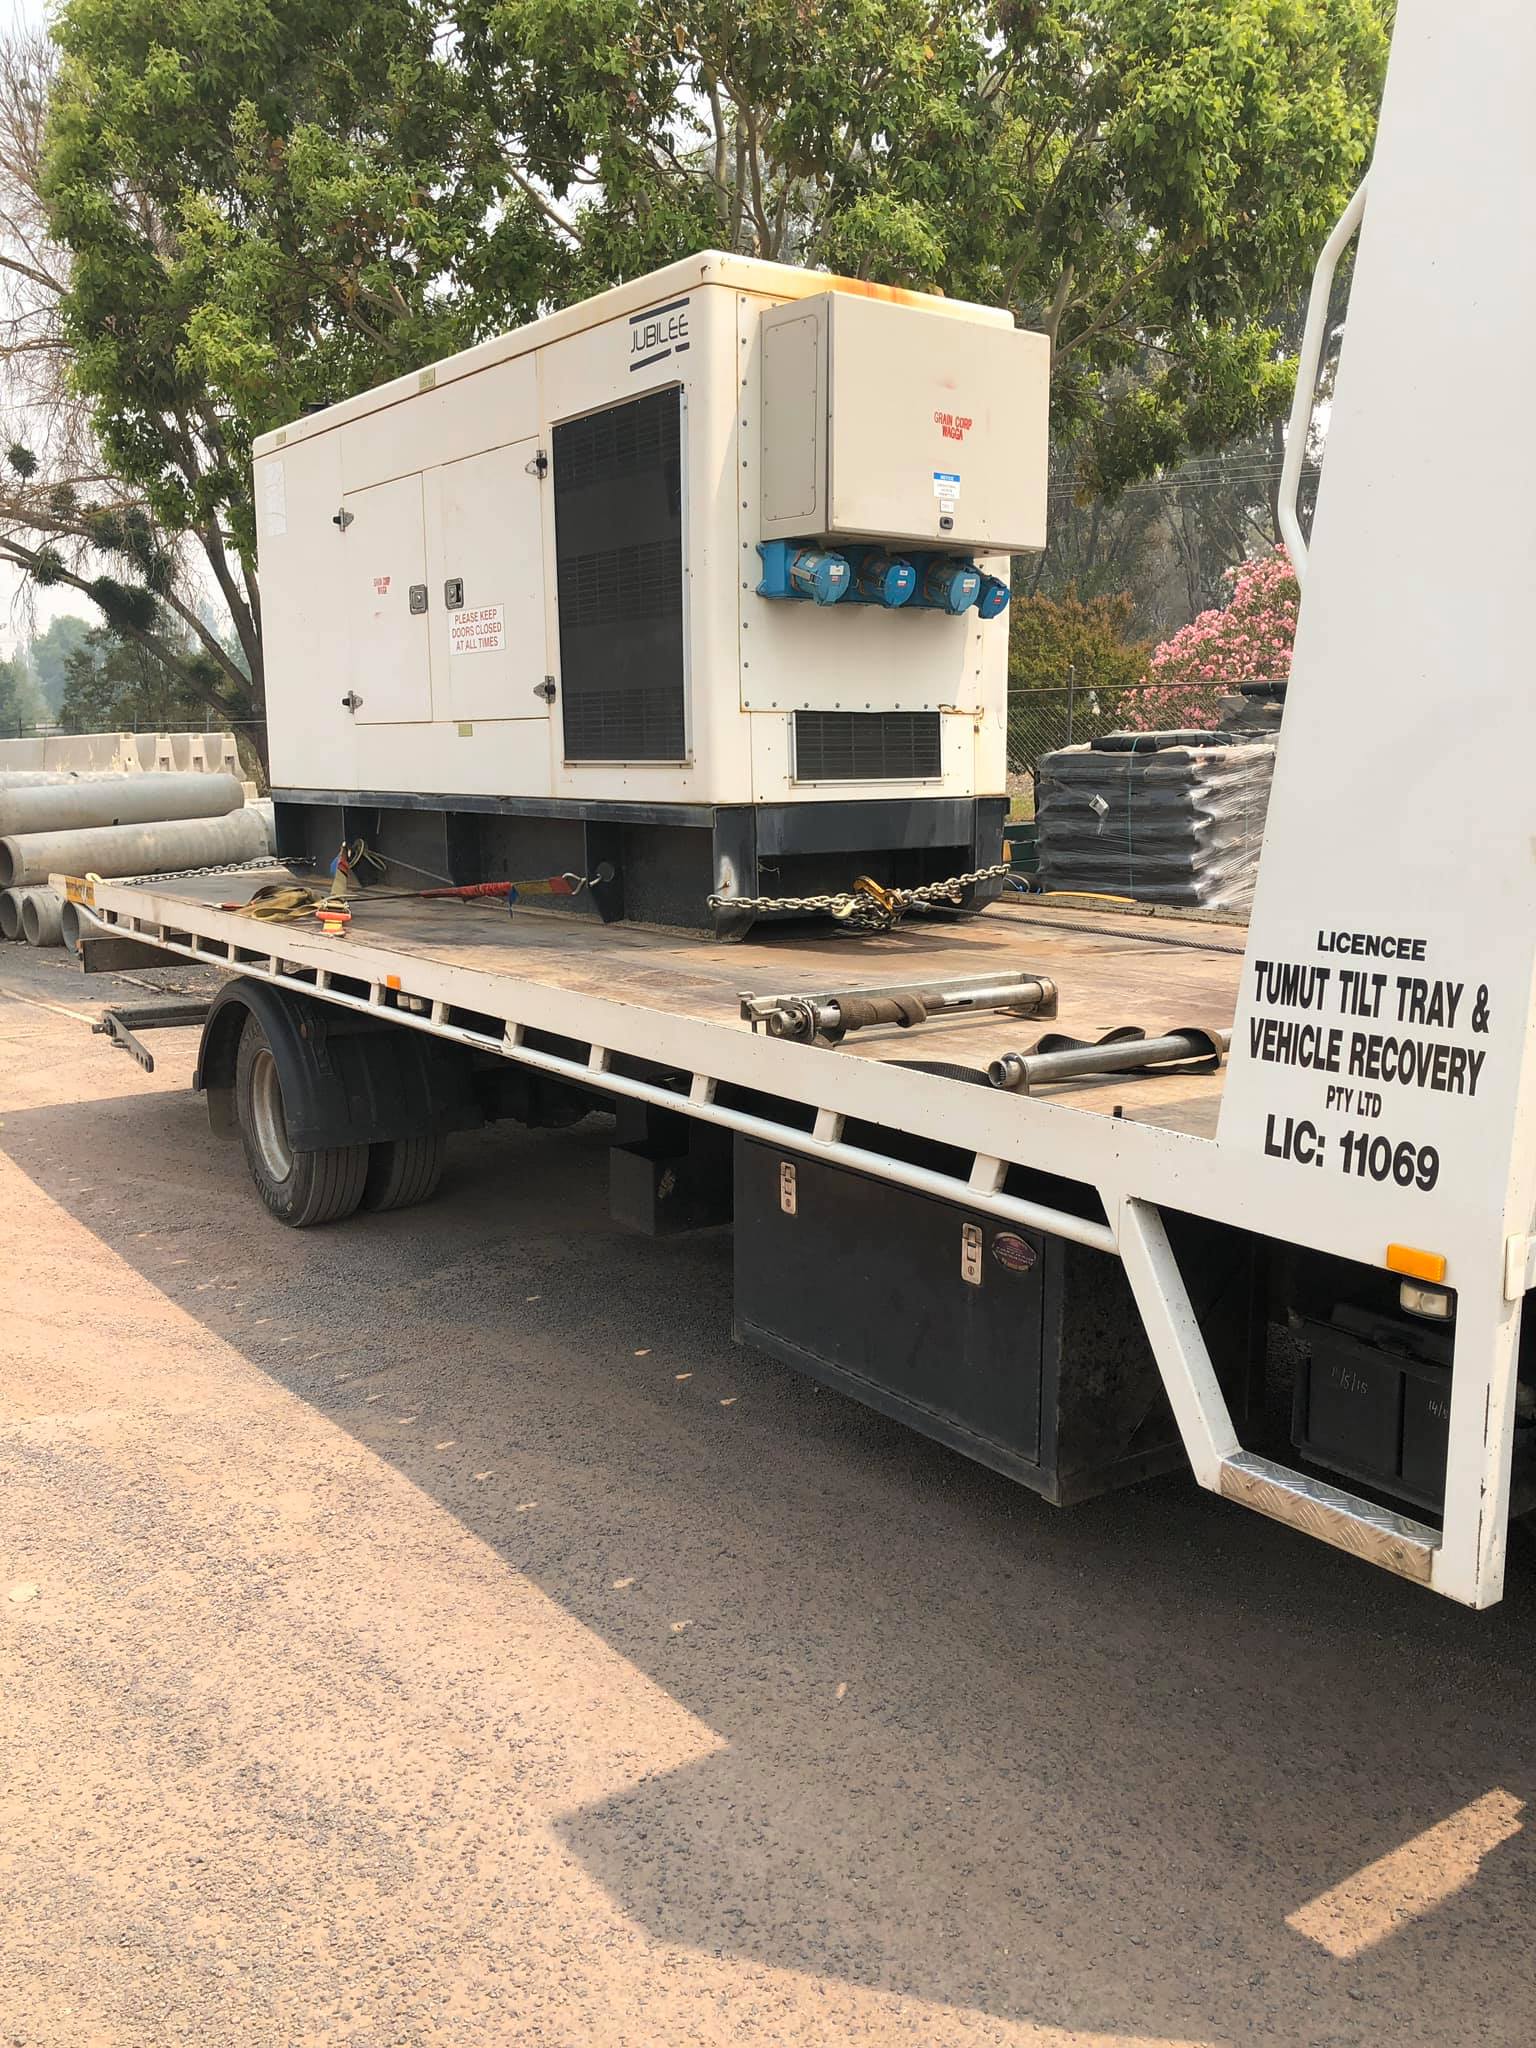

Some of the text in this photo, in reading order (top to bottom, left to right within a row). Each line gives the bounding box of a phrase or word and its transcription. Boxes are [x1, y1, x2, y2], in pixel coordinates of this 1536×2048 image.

[630, 313, 689, 353] JUBILEE
[934, 411, 972, 430] GRAIN CORP
[452, 622, 502, 639] DOORS CLOSED
[455, 609, 497, 625] PLEASE KEEP
[456, 636, 498, 652] AT ALL TIMES
[1317, 930, 1427, 962] LICENCEE
[1255, 960, 1490, 1034] TUMUT TILT TRAY &
[1250, 1017, 1487, 1097] VEHICLE RECOVERY
[1326, 1085, 1382, 1118] PTY LTD
[1264, 1114, 1440, 1192] LIC: 11069
